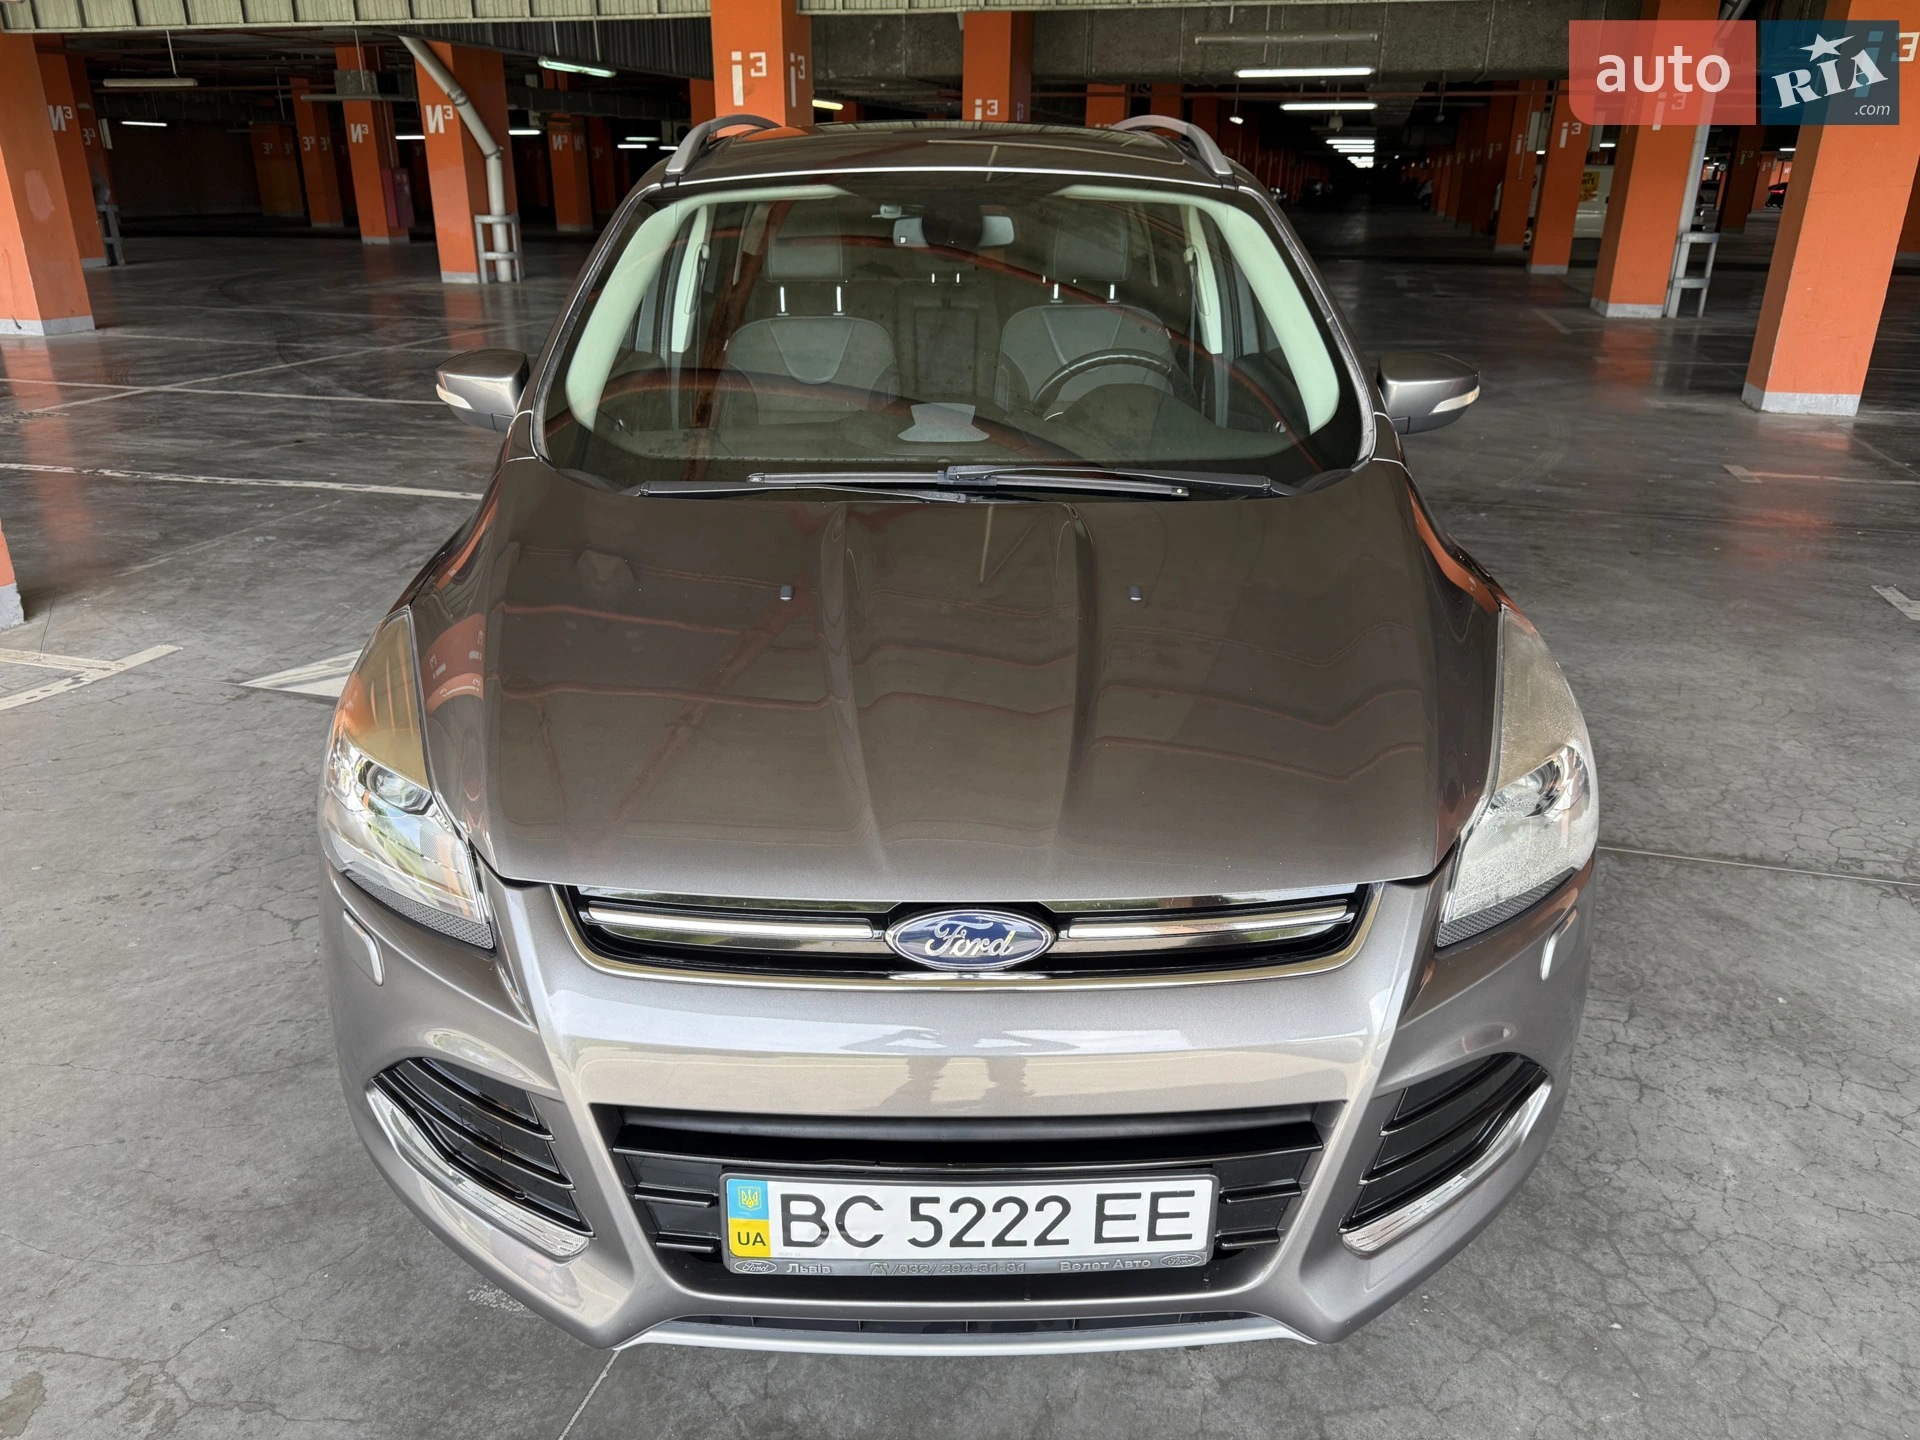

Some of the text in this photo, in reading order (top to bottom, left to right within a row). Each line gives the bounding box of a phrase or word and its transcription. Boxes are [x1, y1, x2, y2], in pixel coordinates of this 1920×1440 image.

[925, 918, 1016, 956] Ford
[780, 1190, 1195, 1248] BC 5222 EE
[737, 1232, 767, 1246] UA
[786, 1263, 832, 1274] Львів
[1113, 1259, 1151, 1269] Авто
